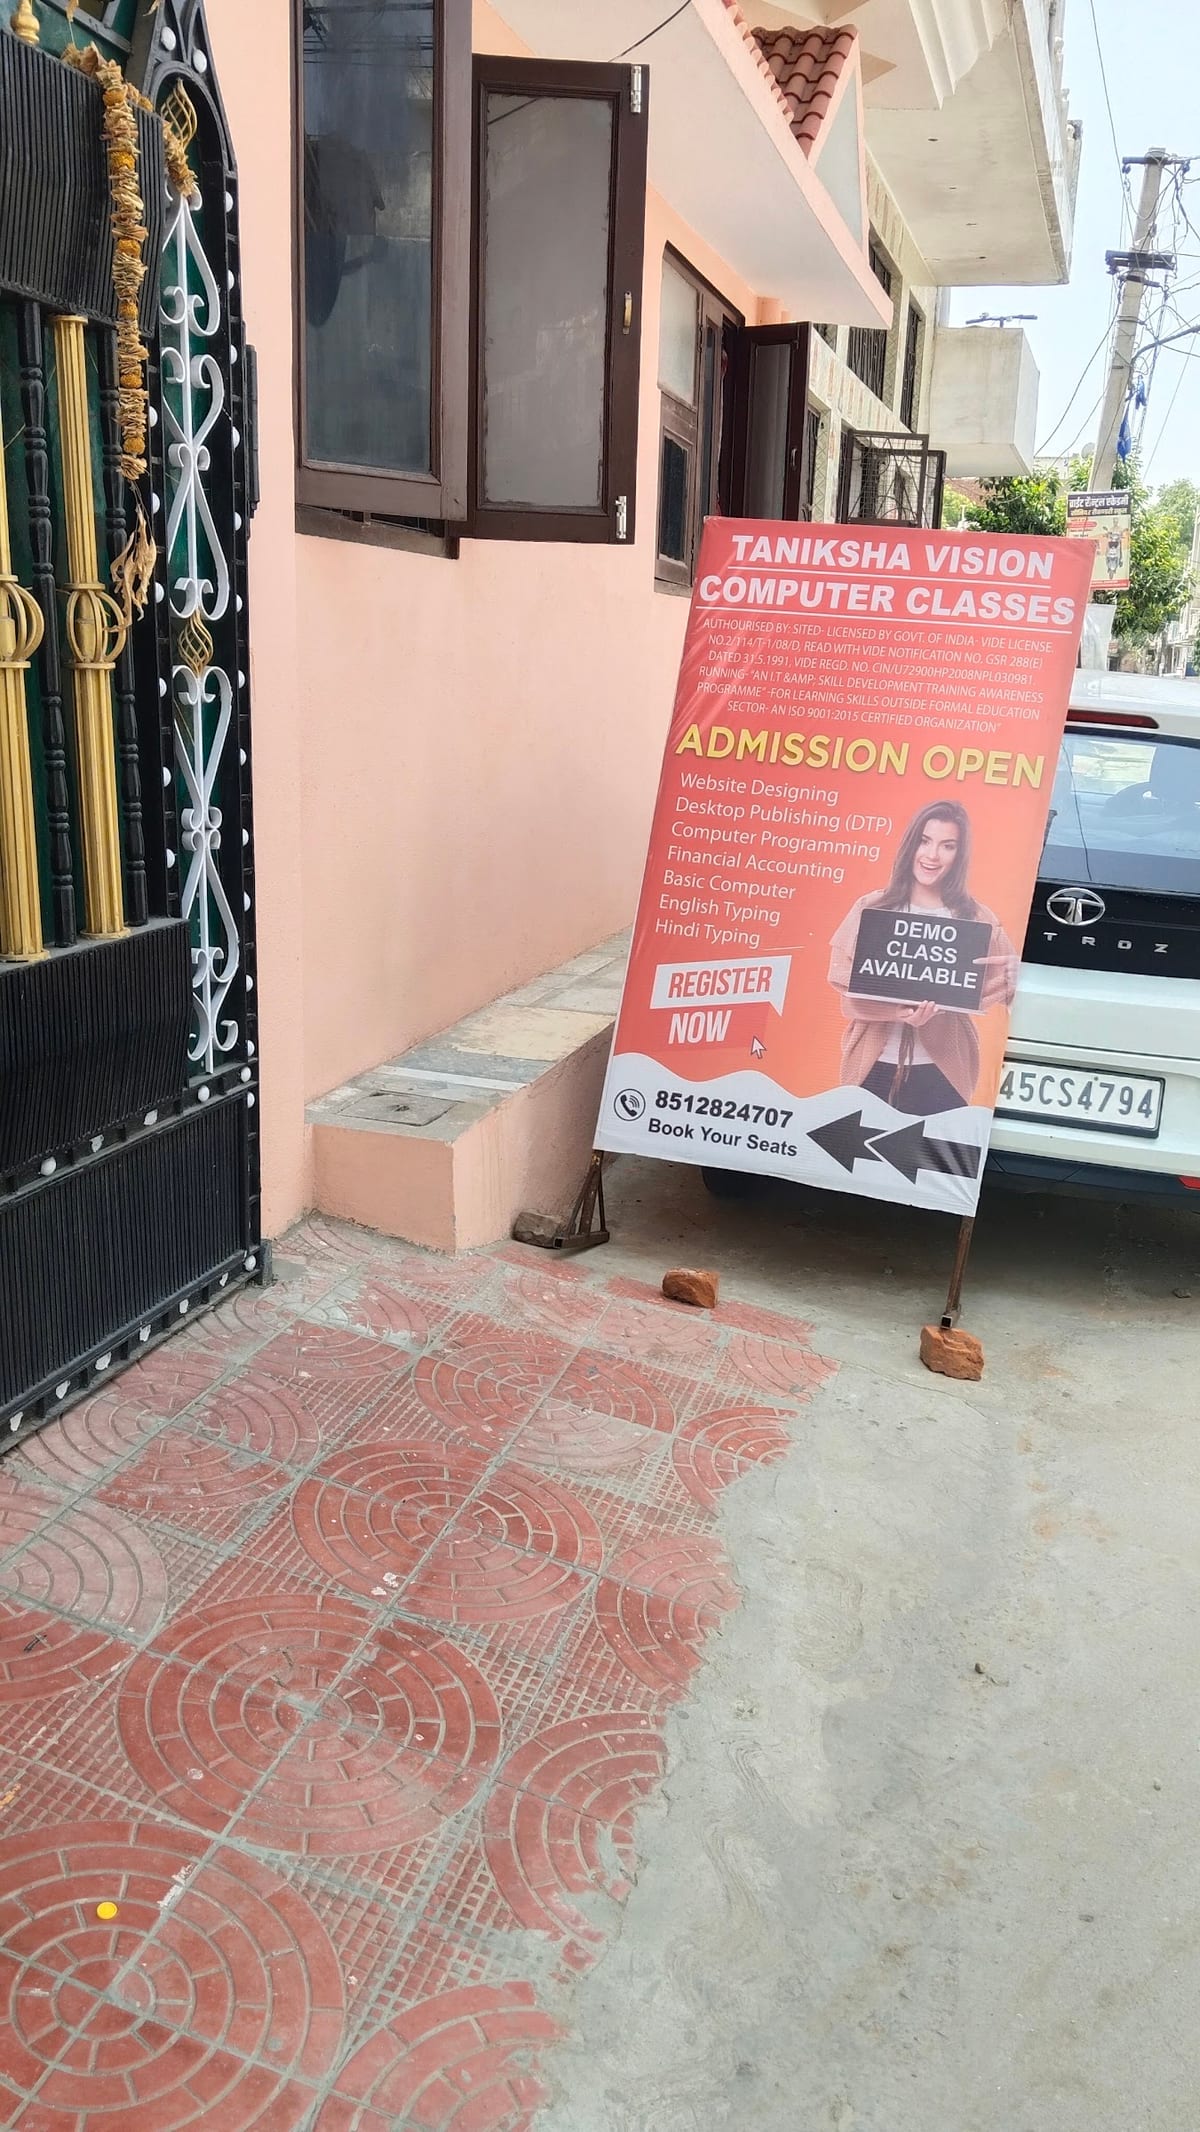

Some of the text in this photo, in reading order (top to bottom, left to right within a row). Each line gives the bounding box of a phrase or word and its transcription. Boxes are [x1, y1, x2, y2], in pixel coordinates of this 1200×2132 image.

[731, 534, 1054, 580] TANIKSHA VISION
[700, 575, 1076, 626] COMPUTER CLASSES
[703, 617, 774, 633] AUTHOURISED
[776, 622, 791, 634] BY:
[792, 623, 824, 636] SITED-
[827, 626, 876, 640] LICENSED
[879, 628, 891, 640] BY
[894, 630, 925, 643] GOVT.
[928, 632, 943, 644] OF
[945, 634, 978, 647] INDIA-
[981, 637, 1005, 649] VIDE
[708, 650, 742, 663] DATED
[743, 654, 791, 668] 31.5.1991,
[794, 657, 817, 669] VIDE
[820, 658, 849, 671] REGD.
[851, 661, 869, 673] NO.
[804, 641, 831, 653] READ
[834, 643, 860, 656] WITH
[862, 645, 886, 657] VIDE
[888, 647, 962, 662] NOTIFICATION
[964, 652, 983, 664] NO.
[986, 653, 1007, 666] GSR
[1009, 656, 1043, 669] 288(E)
[699, 665, 749, 680] RUNNING-
[818, 674, 845, 687] SKILL
[847, 677, 926, 693] DEVELOPMENT
[926, 682, 977, 698] TRAINING
[979, 687, 1044, 703] AWARENESS
[727, 700, 768, 713] SECTOR-
[770, 704, 787, 715] AN
[788, 705, 805, 717] ISO
[807, 707, 859, 721] 9001:2015
[861, 711, 913, 726] CERTIFIED
[793, 689, 844, 704] LEARNING
[846, 693, 879, 706] SKILLS
[881, 696, 927, 710] OUTSIDE
[929, 699, 973, 714] FORMAL
[976, 703, 1041, 720] EDUCATION
[675, 723, 1045, 789] ADMISSION OPEN
[680, 772, 839, 806] Website Designing
[675, 797, 893, 836] Desktop Publishing (DTP)
[671, 821, 881, 862] Computer Programming
[667, 845, 845, 884] Financial Accounting
[663, 869, 796, 901] Basic Computer
[658, 893, 781, 927] English Typing
[655, 918, 761, 949] Hindi Typing
[893, 919, 957, 942] DEMO
[885, 940, 958, 964] CLASS
[668, 965, 773, 999] REGISTER
[859, 958, 979, 990] AVAILABLE
[668, 1010, 731, 1045] NOW
[655, 1090, 793, 1129] 8512824707
[1000, 1070, 1153, 1119] 45CS4794
[648, 1118, 798, 1157] Book Your Seats
